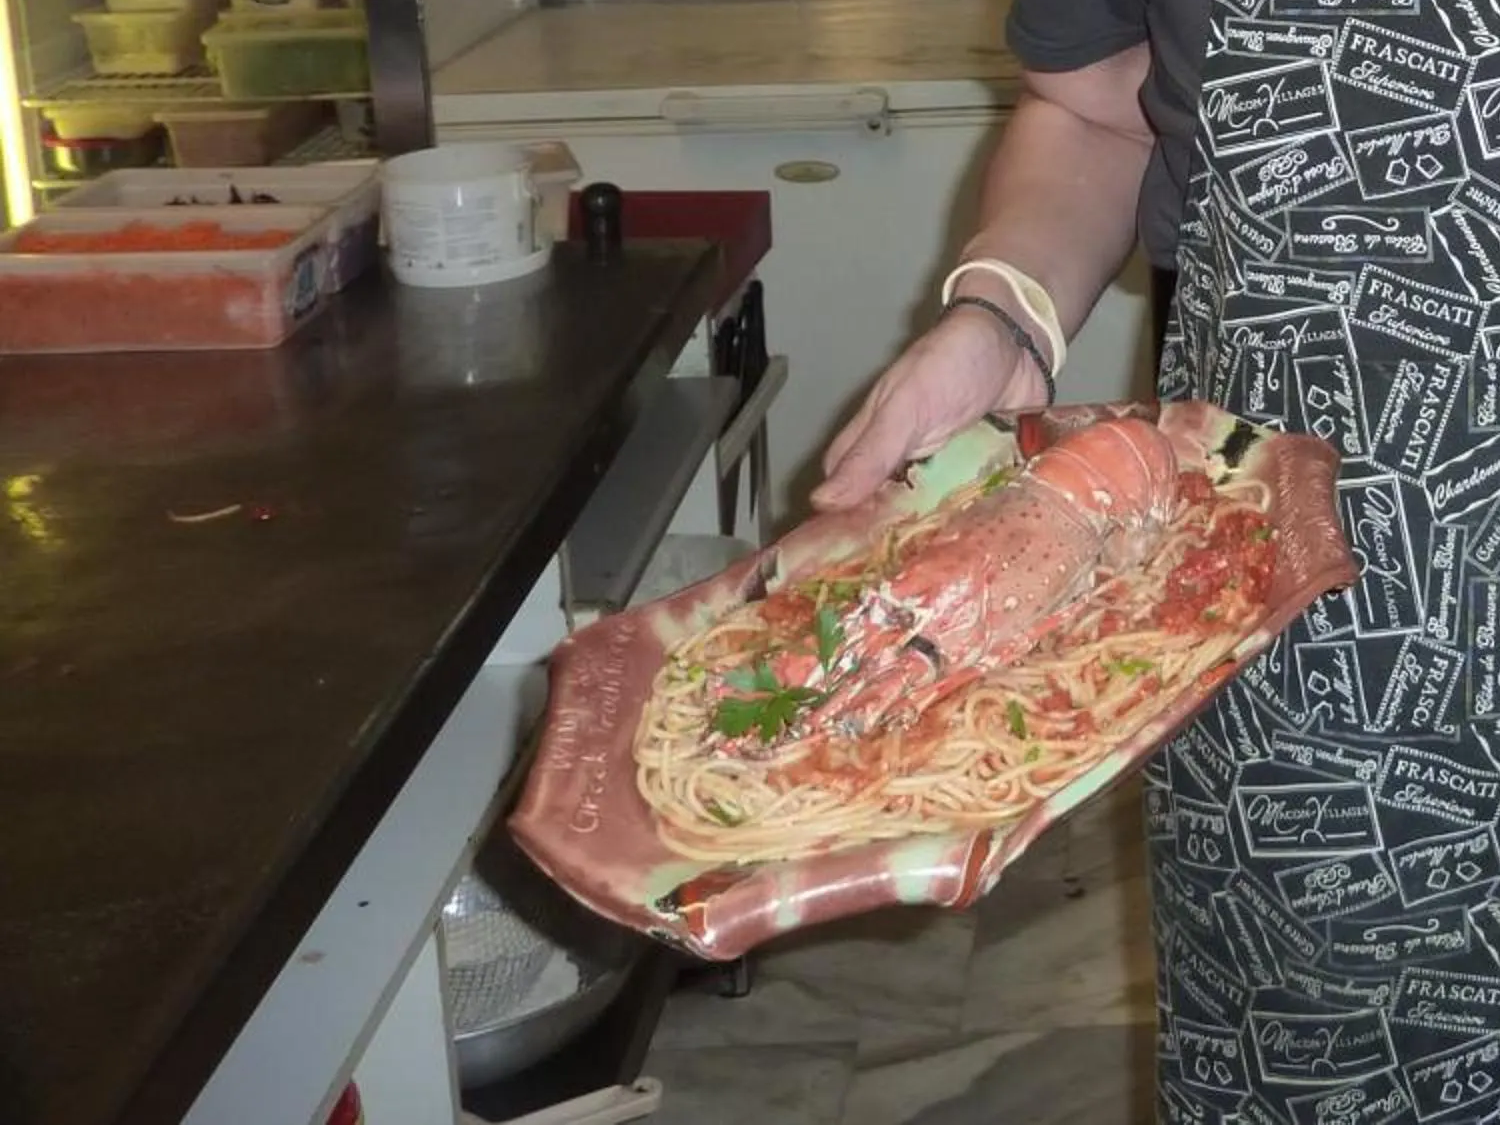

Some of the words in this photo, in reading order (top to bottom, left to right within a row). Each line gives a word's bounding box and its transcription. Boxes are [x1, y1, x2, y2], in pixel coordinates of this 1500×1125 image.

[1350, 32, 1462, 83] FRASCATI
[1368, 279, 1474, 328] FRASCATI
[1401, 362, 1450, 470] FRASCATI
[1394, 760, 1498, 798] FRASCATI
